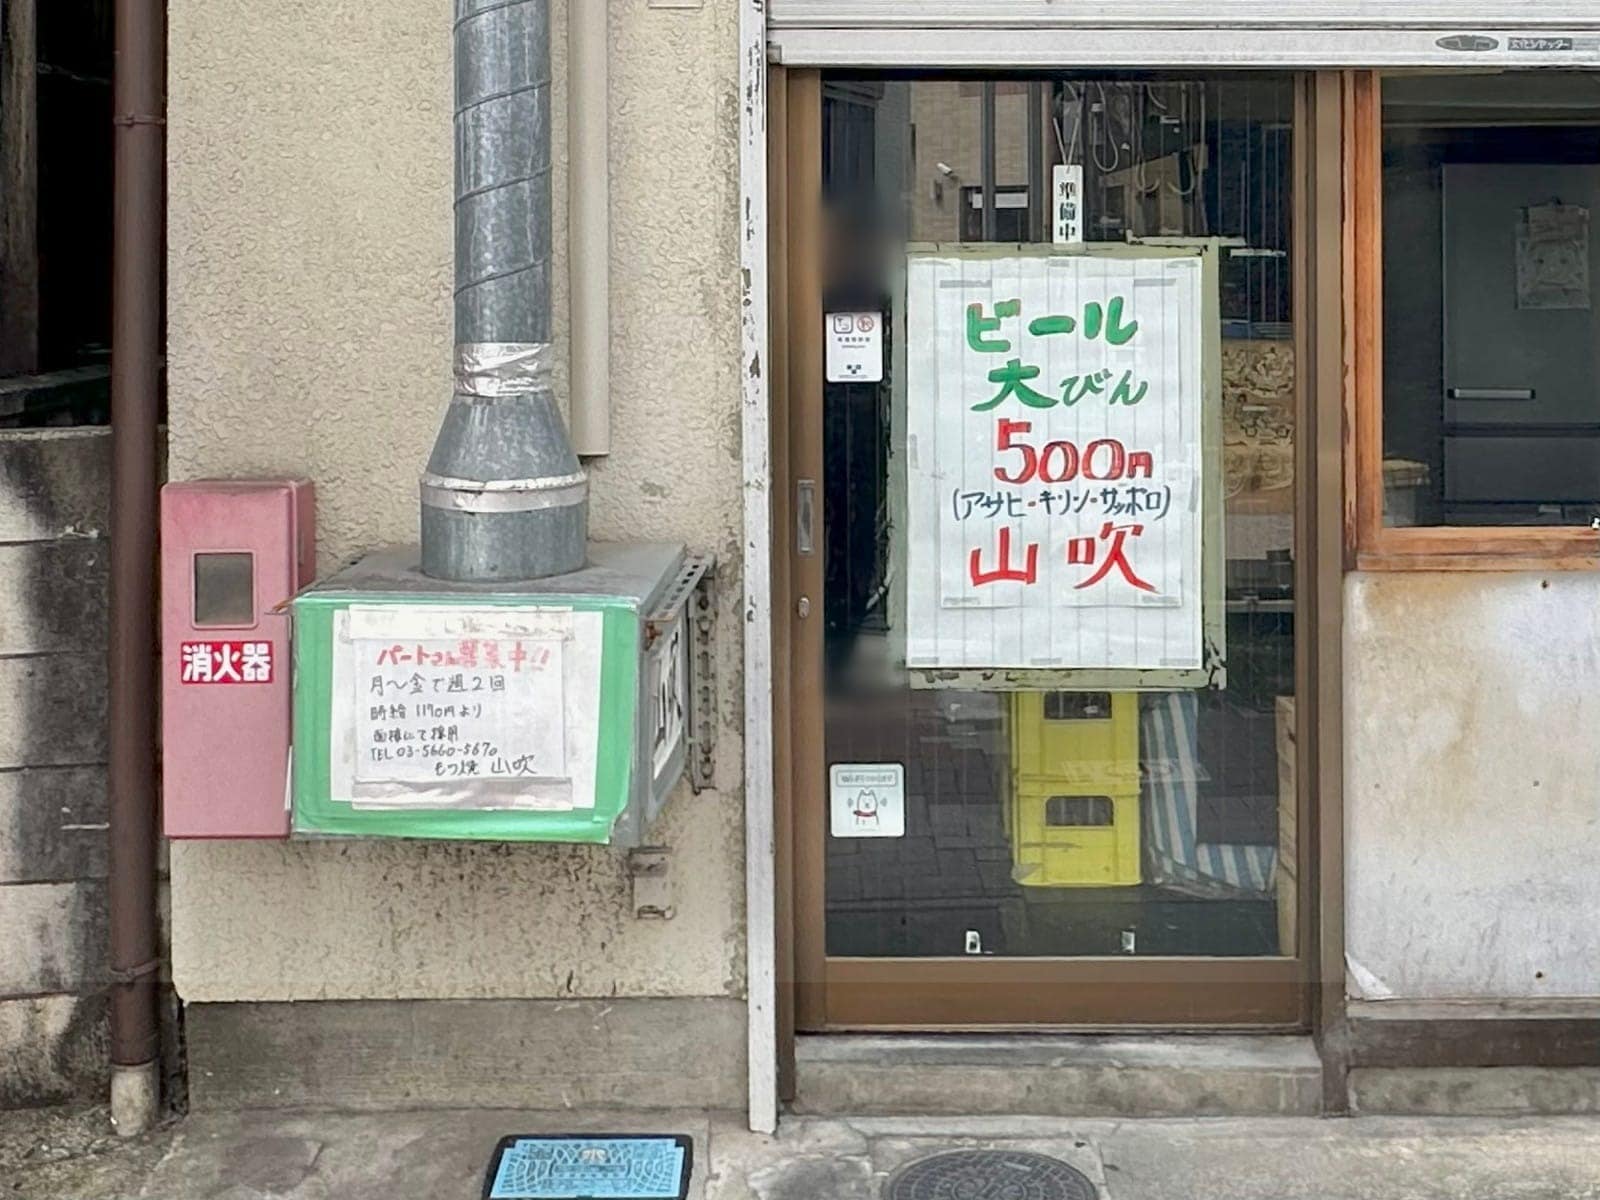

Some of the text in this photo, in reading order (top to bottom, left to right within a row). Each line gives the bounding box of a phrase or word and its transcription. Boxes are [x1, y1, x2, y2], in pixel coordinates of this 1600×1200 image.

[1059, 181, 1077, 241] 準備中
[966, 296, 1138, 353] ビール
[970, 358, 1149, 412] 大びん
[993, 418, 1154, 484] 500円
[969, 521, 1160, 594] 山吹
[182, 643, 272, 682] 消火器
[371, 746, 394, 761] TEL
[373, 724, 459, 744] 面接にて採用
[435, 753, 537, 777] もつ焼 山吹
